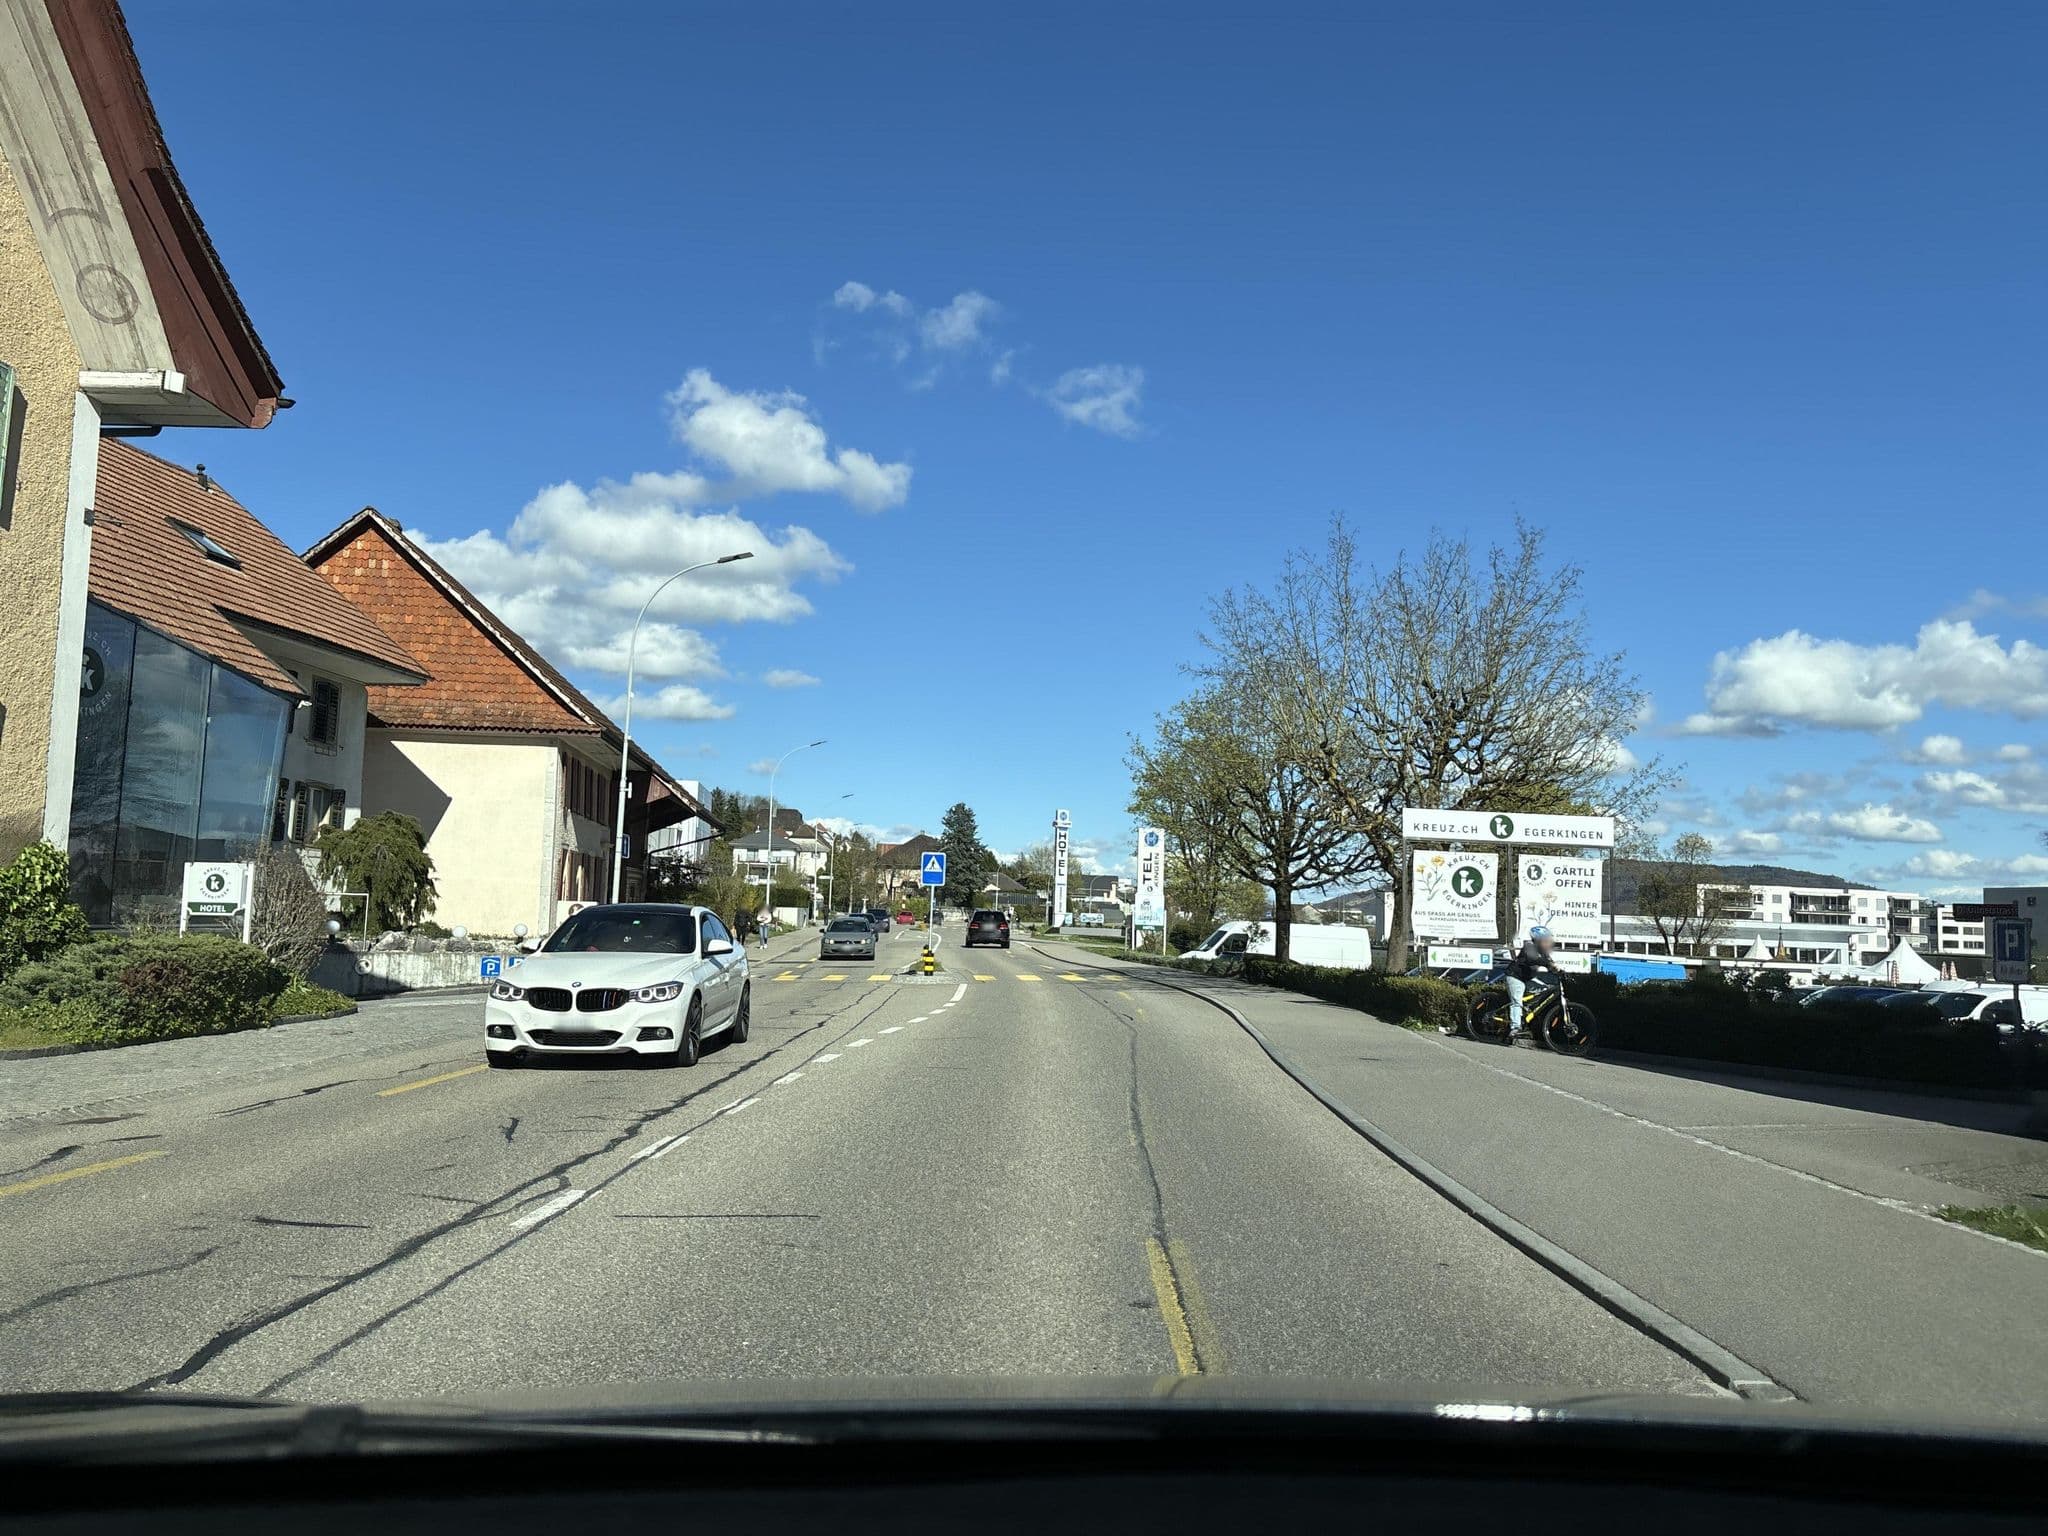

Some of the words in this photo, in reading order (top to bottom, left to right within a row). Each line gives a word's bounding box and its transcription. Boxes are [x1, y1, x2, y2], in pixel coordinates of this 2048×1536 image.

[1413, 822, 1478, 834] KREUZ.CH
[1524, 827, 1603, 840] EGERKINGEN
[1058, 832, 1067, 876] HOTEL
[1447, 855, 1490, 870] KREUZ.CH
[1553, 865, 1595, 876] GÄRTLI
[1555, 879, 1592, 888] OFFEN
[1443, 889, 1492, 909] EGERKINGEN
[1564, 901, 1598, 909] HINTER
[200, 904, 226, 912] HOTEL
[1571, 911, 1598, 919] HAUS.
[2005, 929, 2018, 960] P
[486, 962, 496, 975] P
